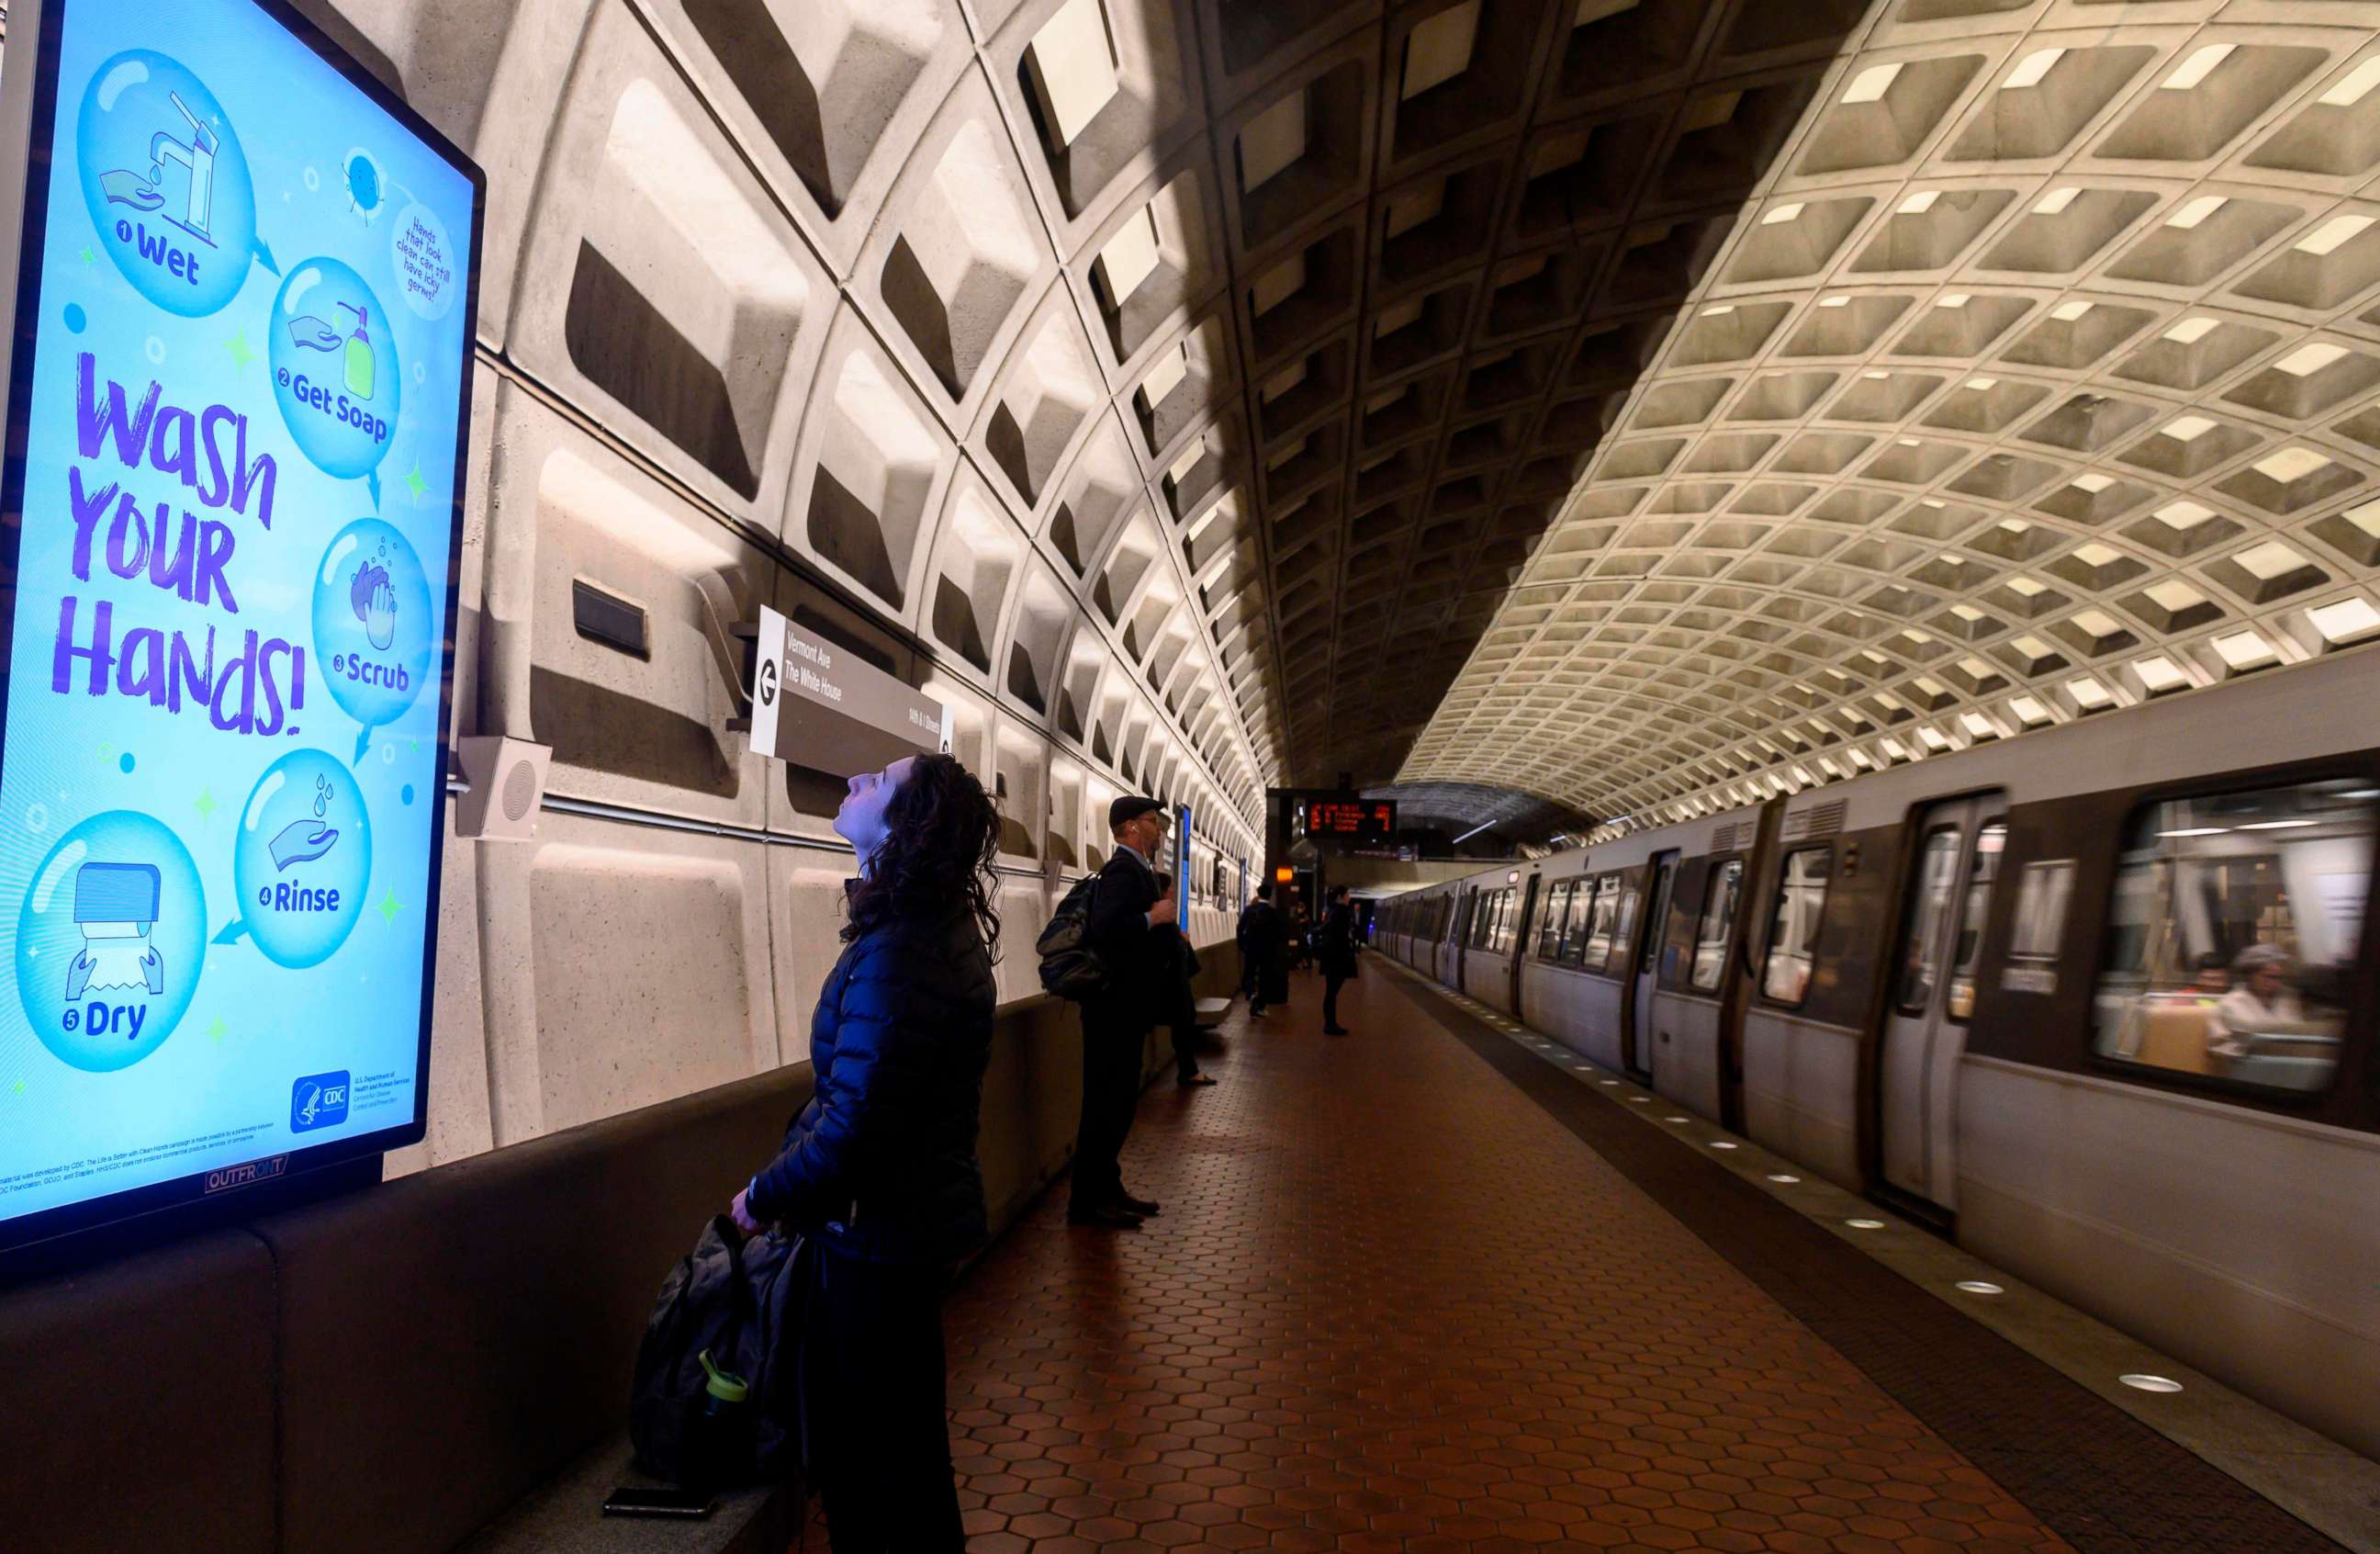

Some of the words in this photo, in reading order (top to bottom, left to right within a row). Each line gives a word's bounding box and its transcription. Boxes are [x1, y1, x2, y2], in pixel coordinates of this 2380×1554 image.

[406, 229, 423, 250] that
[426, 242, 441, 264] look
[412, 216, 436, 244] Hands
[137, 222, 199, 286] Wet
[397, 240, 418, 261] clean
[420, 256, 433, 273] can
[436, 265, 450, 284] still
[404, 257, 422, 279] have
[424, 272, 440, 294] icky
[408, 278, 435, 302] germs!
[294, 375, 332, 414] Get
[337, 396, 387, 445] Soap
[787, 631, 817, 663] Vermont
[817, 647, 831, 670] Ave
[347, 653, 410, 692] Scrub
[785, 659, 800, 682] The
[800, 666, 821, 693] White
[820, 676, 842, 703] House
[275, 879, 340, 912] Rinse
[86, 1001, 147, 1041] Dry
[324, 1088, 344, 1105] CDC
[209, 1158, 283, 1188] OUTFRONT
